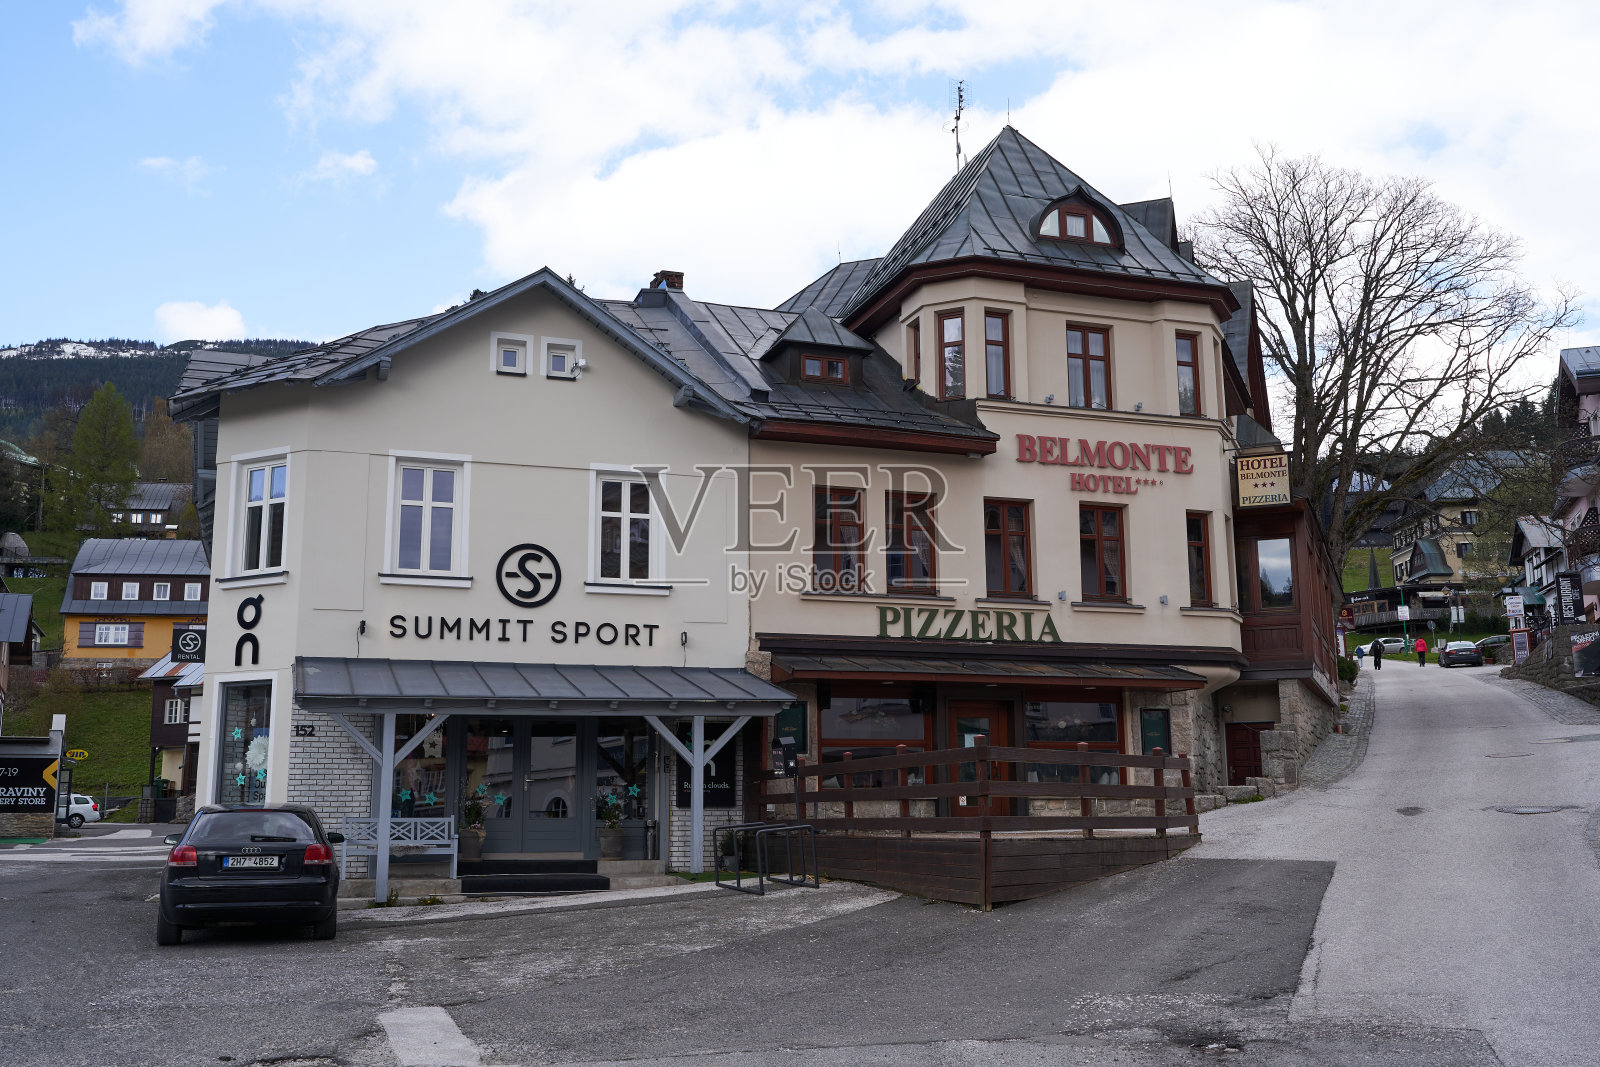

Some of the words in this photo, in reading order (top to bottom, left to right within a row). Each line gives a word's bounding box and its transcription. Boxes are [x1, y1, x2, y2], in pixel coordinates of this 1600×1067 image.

[1016, 434, 1194, 474] BELMONTE
[1239, 457, 1287, 471] HOTEL
[1240, 470, 1288, 480] BELMONTE
[1070, 473, 1138, 494] HOTEL
[1241, 494, 1288, 504] PIZZERIA
[1560, 577, 1574, 618] RESTAURANT
[389, 615, 533, 642] SUMMIT
[551, 621, 659, 647] SPORT
[876, 605, 1063, 643] PIZZERIA
[294, 725, 316, 737] 152
[0, 768, 18, 776] 7-19
[230, 857, 247, 867] 2H7
[253, 857, 274, 866] 4852
